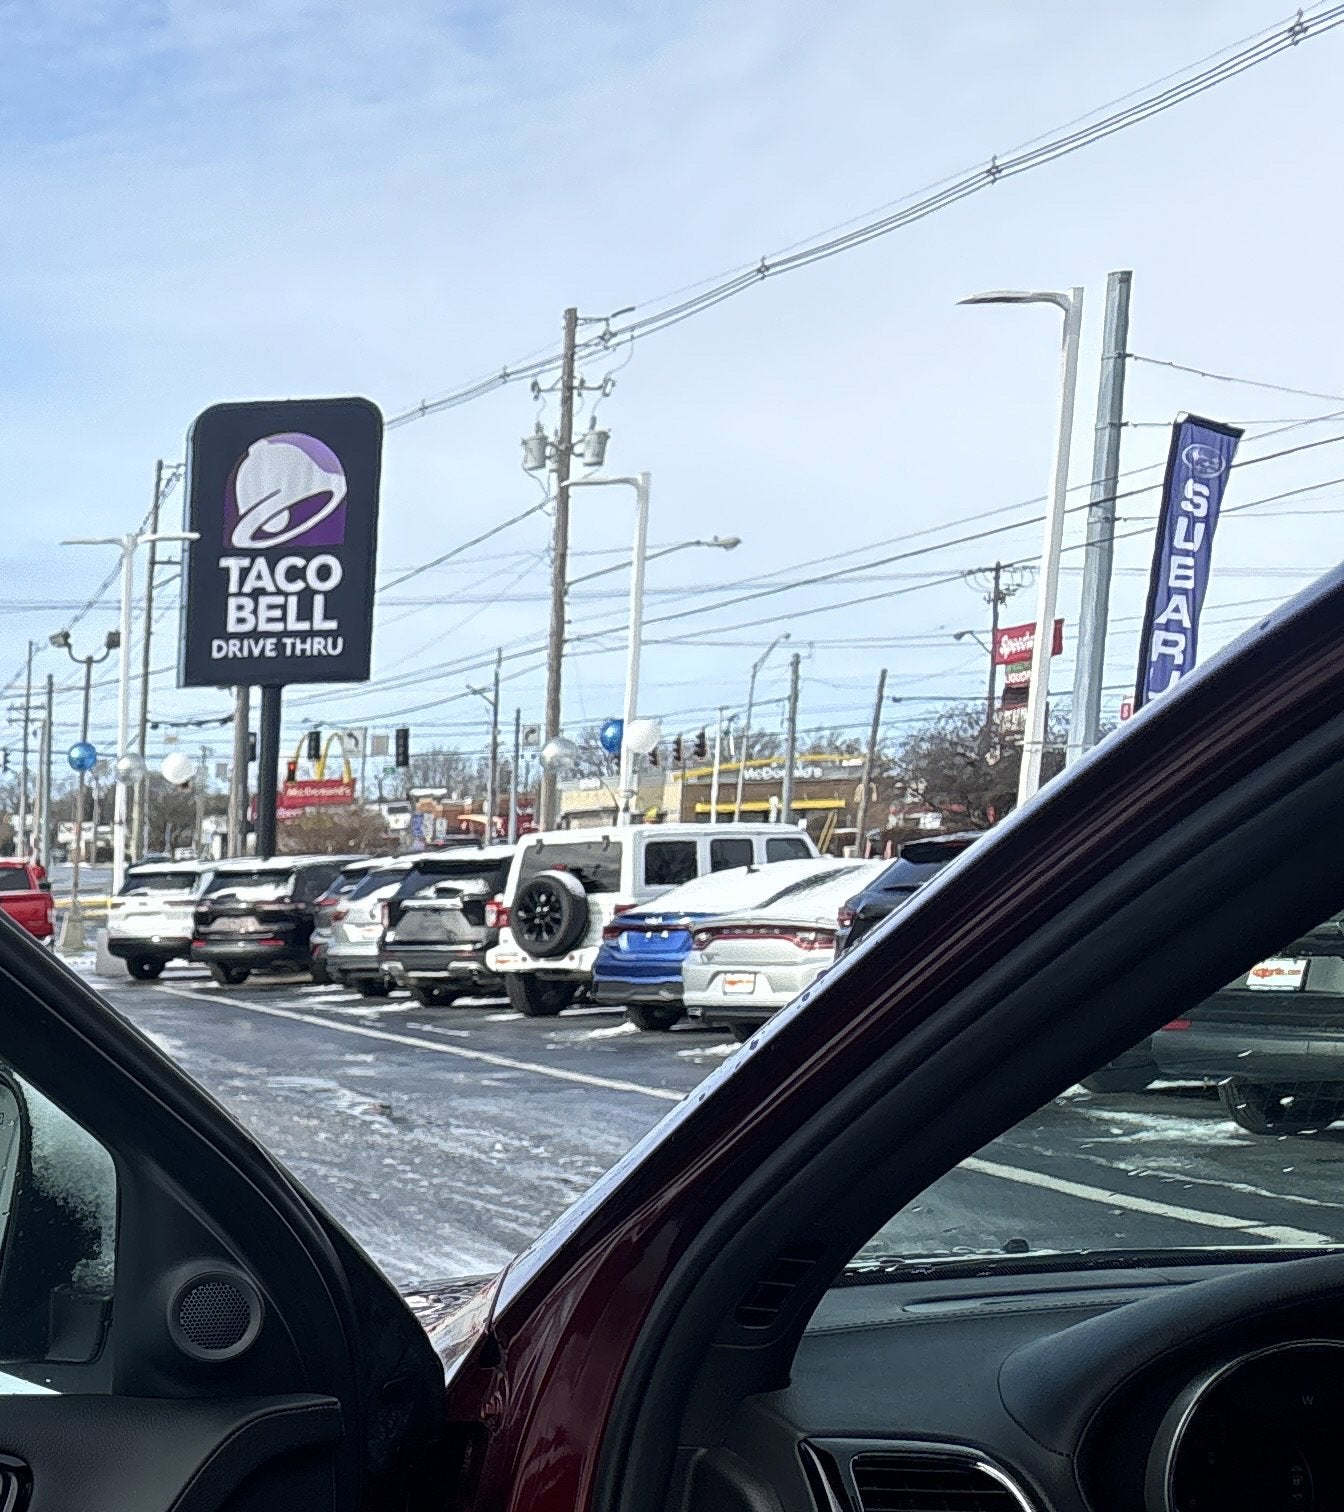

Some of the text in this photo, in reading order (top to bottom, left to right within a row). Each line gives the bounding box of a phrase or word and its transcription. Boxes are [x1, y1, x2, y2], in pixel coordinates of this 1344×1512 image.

[218, 554, 343, 593] TACO
[226, 594, 339, 633] BELL
[212, 636, 344, 659] DRIVE THRU
